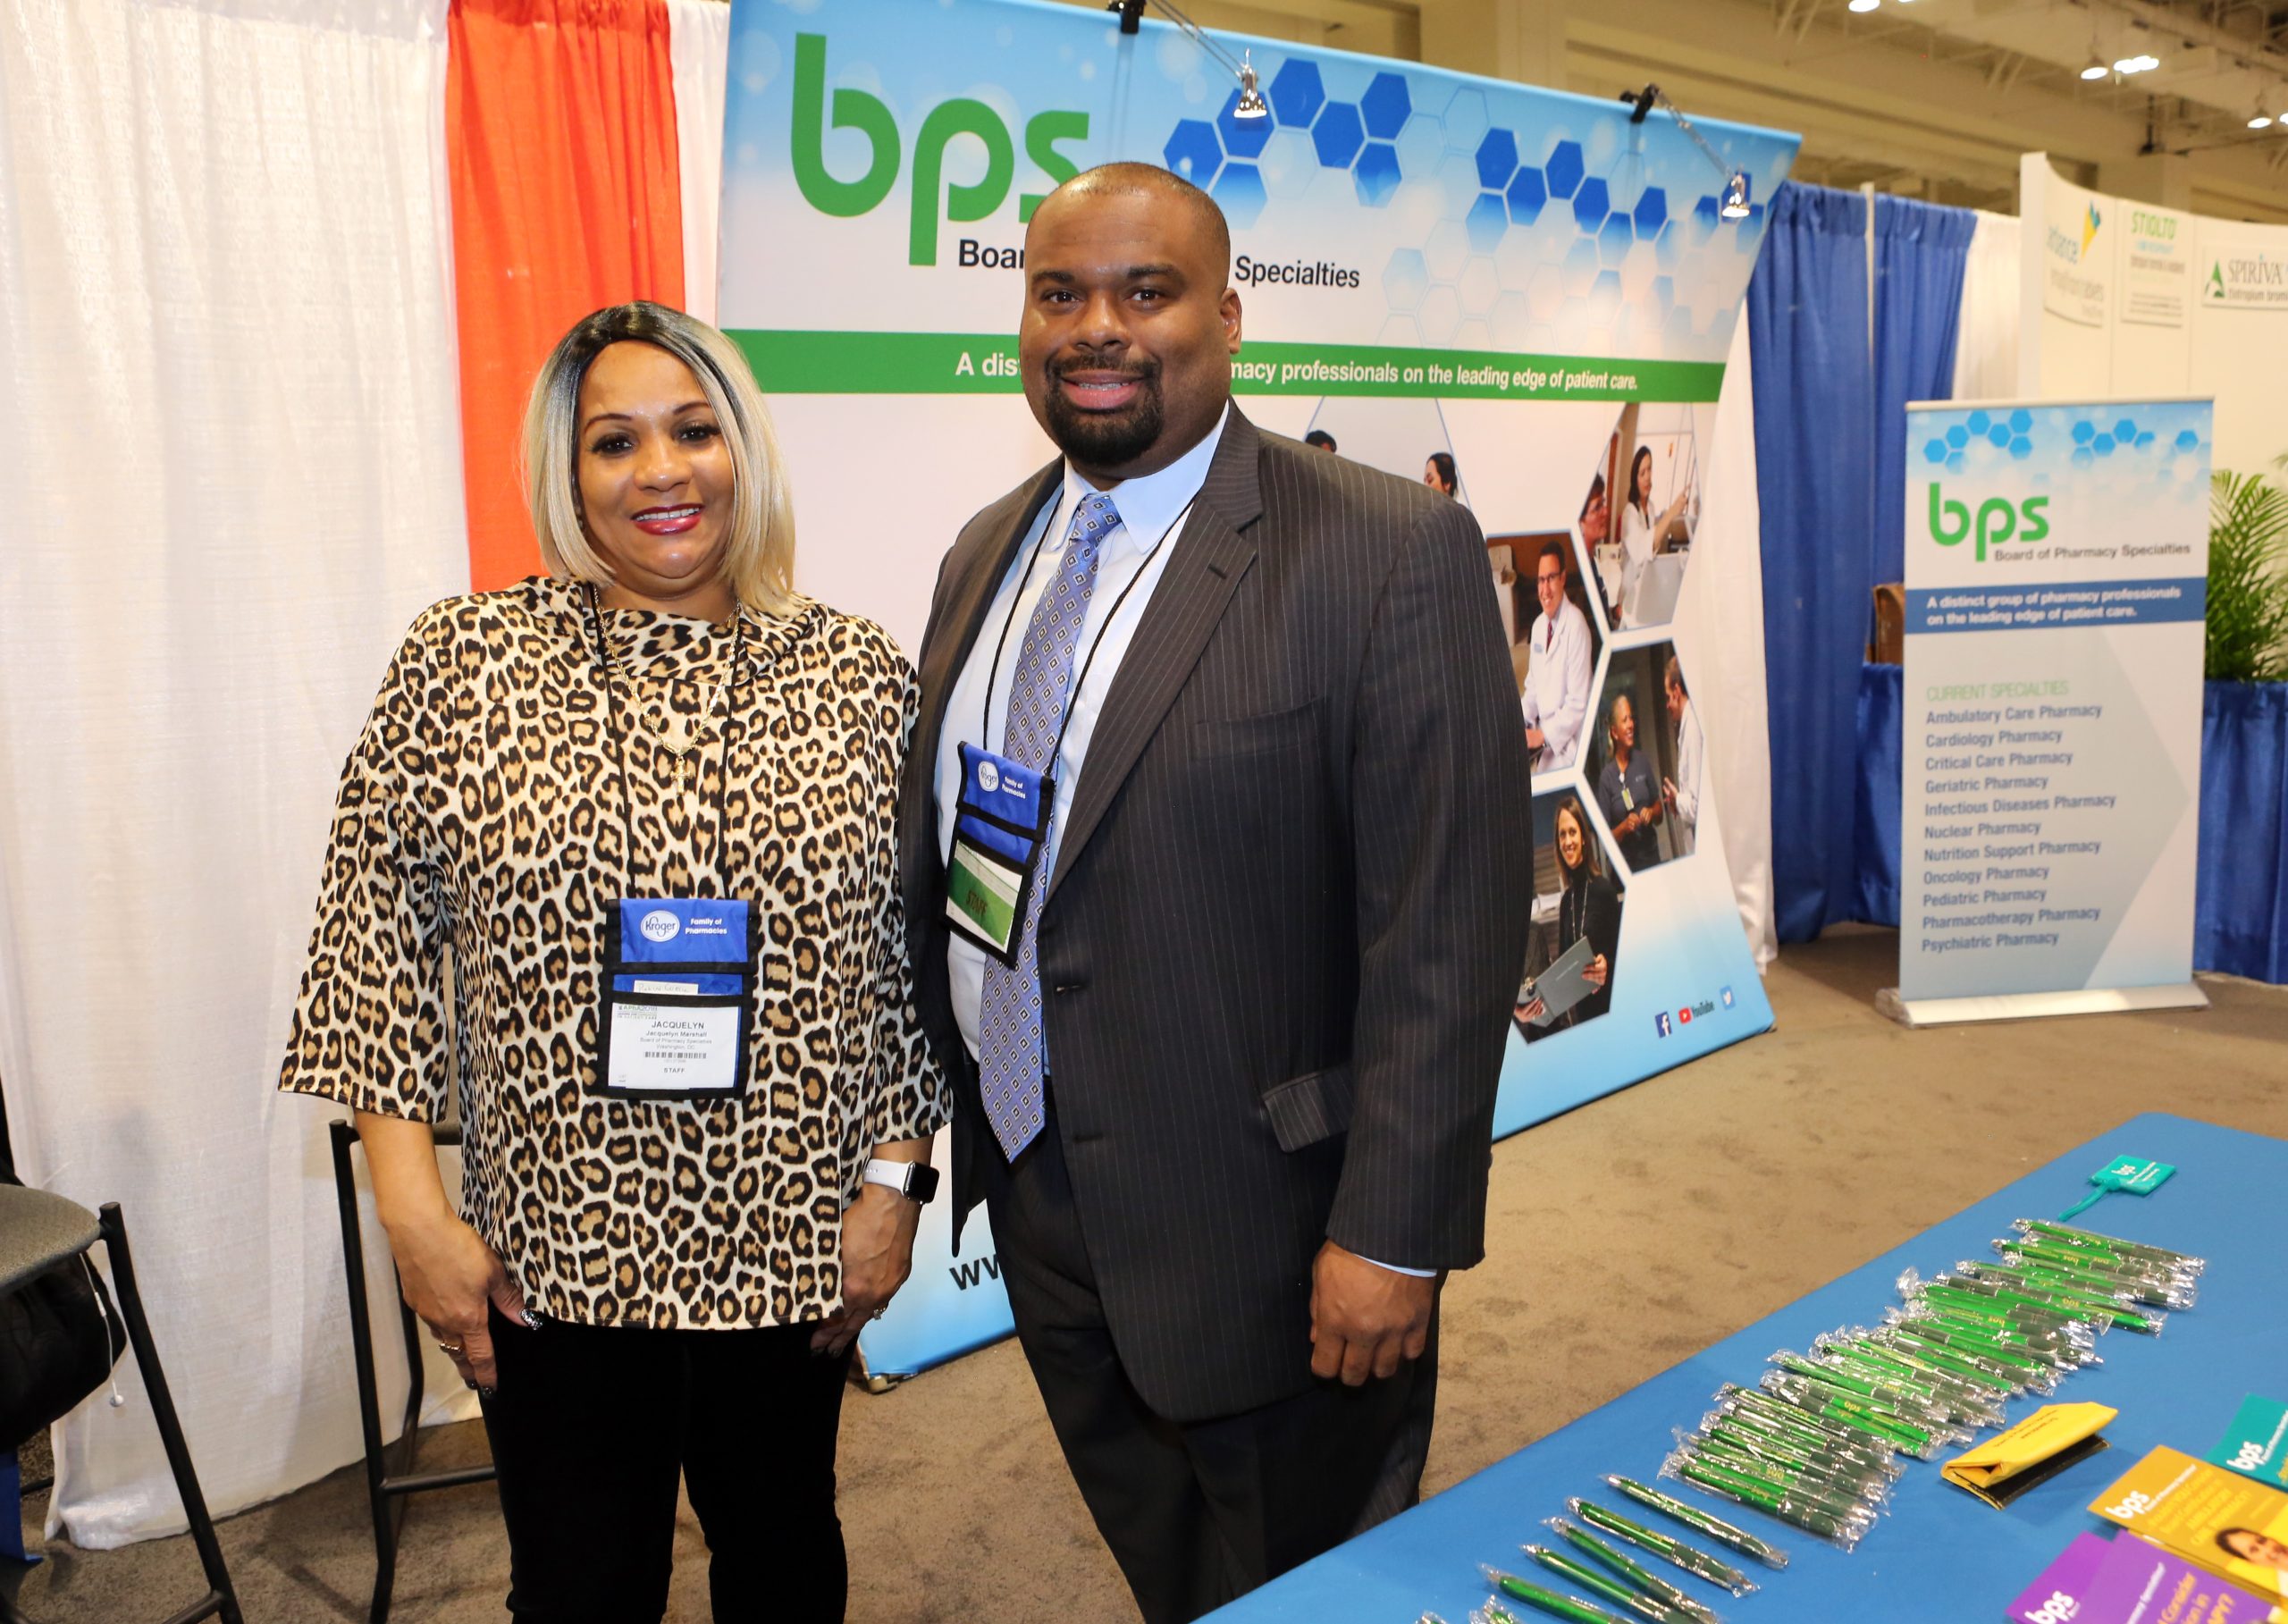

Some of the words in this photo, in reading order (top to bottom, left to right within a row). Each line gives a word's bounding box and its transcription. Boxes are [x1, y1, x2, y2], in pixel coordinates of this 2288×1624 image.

[791, 32, 1089, 266] bps
[1234, 256, 1360, 289] Specialties
[955, 351, 975, 375] A
[1281, 360, 1400, 384] professionals
[1403, 367, 1424, 383] on
[1428, 365, 1452, 384] the
[1457, 366, 1510, 391] leading
[1513, 368, 1546, 391] edge
[1550, 370, 1565, 387] of
[1565, 371, 1609, 392] patient
[1610, 375, 1638, 391] care.
[1929, 483, 2049, 562] bps
[1995, 550, 2033, 561] Board
[2037, 549, 2050, 560] of
[2055, 546, 2118, 560] Pharmacy
[2122, 543, 2191, 558] Specialties
[1927, 597, 1938, 609] A
[1940, 594, 1985, 609] distinct
[1988, 595, 2023, 610] group
[2026, 592, 2039, 605] of
[2041, 591, 2099, 606] pharmacy
[2102, 586, 2182, 603] professionals
[1927, 614, 1944, 626] on
[1947, 611, 1967, 625] the
[1969, 610, 2013, 626] leading
[2015, 610, 2045, 625] edge
[2048, 608, 2060, 620] of
[2063, 606, 2104, 622] patient
[2107, 606, 2137, 618] care.
[1926, 685, 1987, 702] CURRENT
[1989, 680, 2069, 698] SPECIALTIES
[1926, 709, 2001, 725] Ambulatory
[2005, 706, 2034, 720] Care
[2040, 704, 2102, 719] Pharmacy
[1926, 732, 1994, 748] Cardiology
[1998, 728, 2063, 744] Pharmacy
[1925, 755, 1972, 770] Critical
[1976, 753, 2005, 768] Care
[2010, 751, 2074, 766] Pharmacy
[1925, 778, 1981, 794] Geriatric
[1985, 775, 2048, 790] Pharmacy
[1925, 801, 1988, 817] Infectious
[1993, 798, 2049, 812] Diseases
[2054, 795, 2116, 809] Pharmacy
[1925, 824, 1973, 838] Nuclear
[1978, 821, 2041, 836] Pharmacy
[1924, 846, 1980, 862] Nutrition
[1984, 844, 2035, 861] Support
[2039, 840, 2101, 855] Pharmacy
[1923, 870, 1982, 885] Oncology
[1986, 866, 2049, 880] Pharmacy
[1923, 892, 1979, 907] Pediatric
[1983, 888, 2047, 903] Pharmacy
[644, 916, 676, 938] Kroger
[691, 918, 712, 927] Family
[1922, 911, 2034, 929] Pharmacotherapy
[2038, 907, 2100, 921] Pharmacy
[685, 928, 728, 936] Pharmacies
[1922, 935, 1992, 954] Psychiatric
[1997, 931, 2059, 947] Pharmacy
[652, 1021, 704, 1029] JACQUELYN
[2226, 1441, 2265, 1471] bps
[2105, 1490, 2149, 1519] bps
[2024, 1590, 2074, 1624] bps
